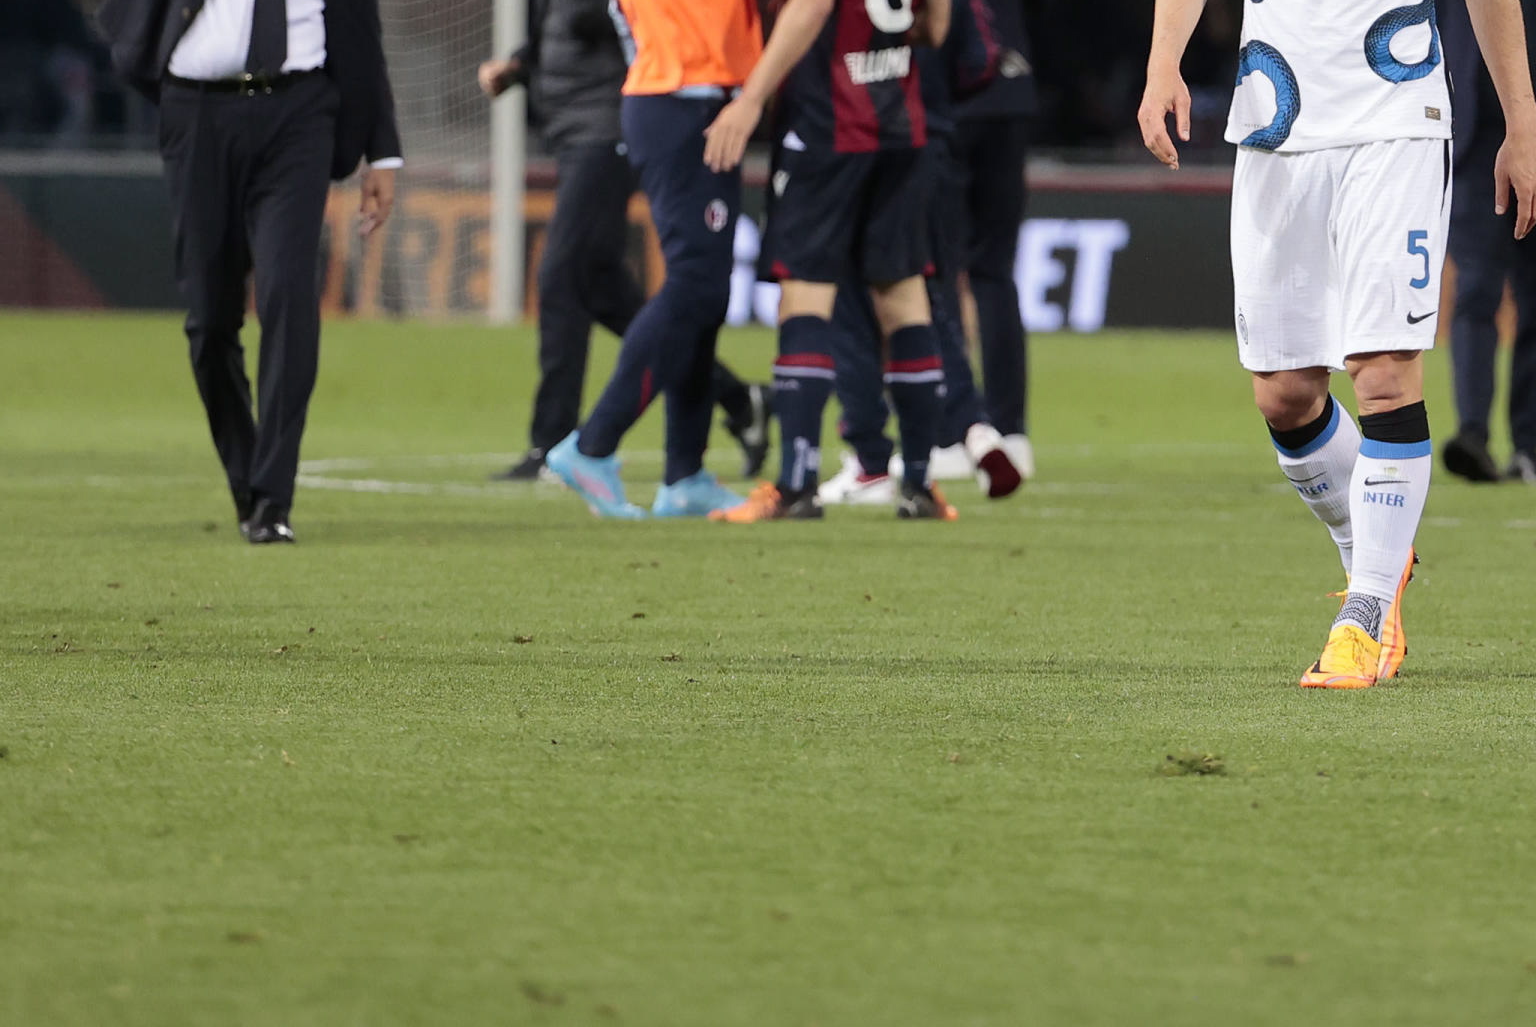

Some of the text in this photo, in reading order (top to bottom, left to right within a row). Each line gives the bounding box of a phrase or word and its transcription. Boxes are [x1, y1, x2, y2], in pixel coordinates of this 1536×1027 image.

[1012, 218, 1130, 332] ET
[1407, 230, 1430, 290] 5
[1363, 490, 1405, 508] INTER
